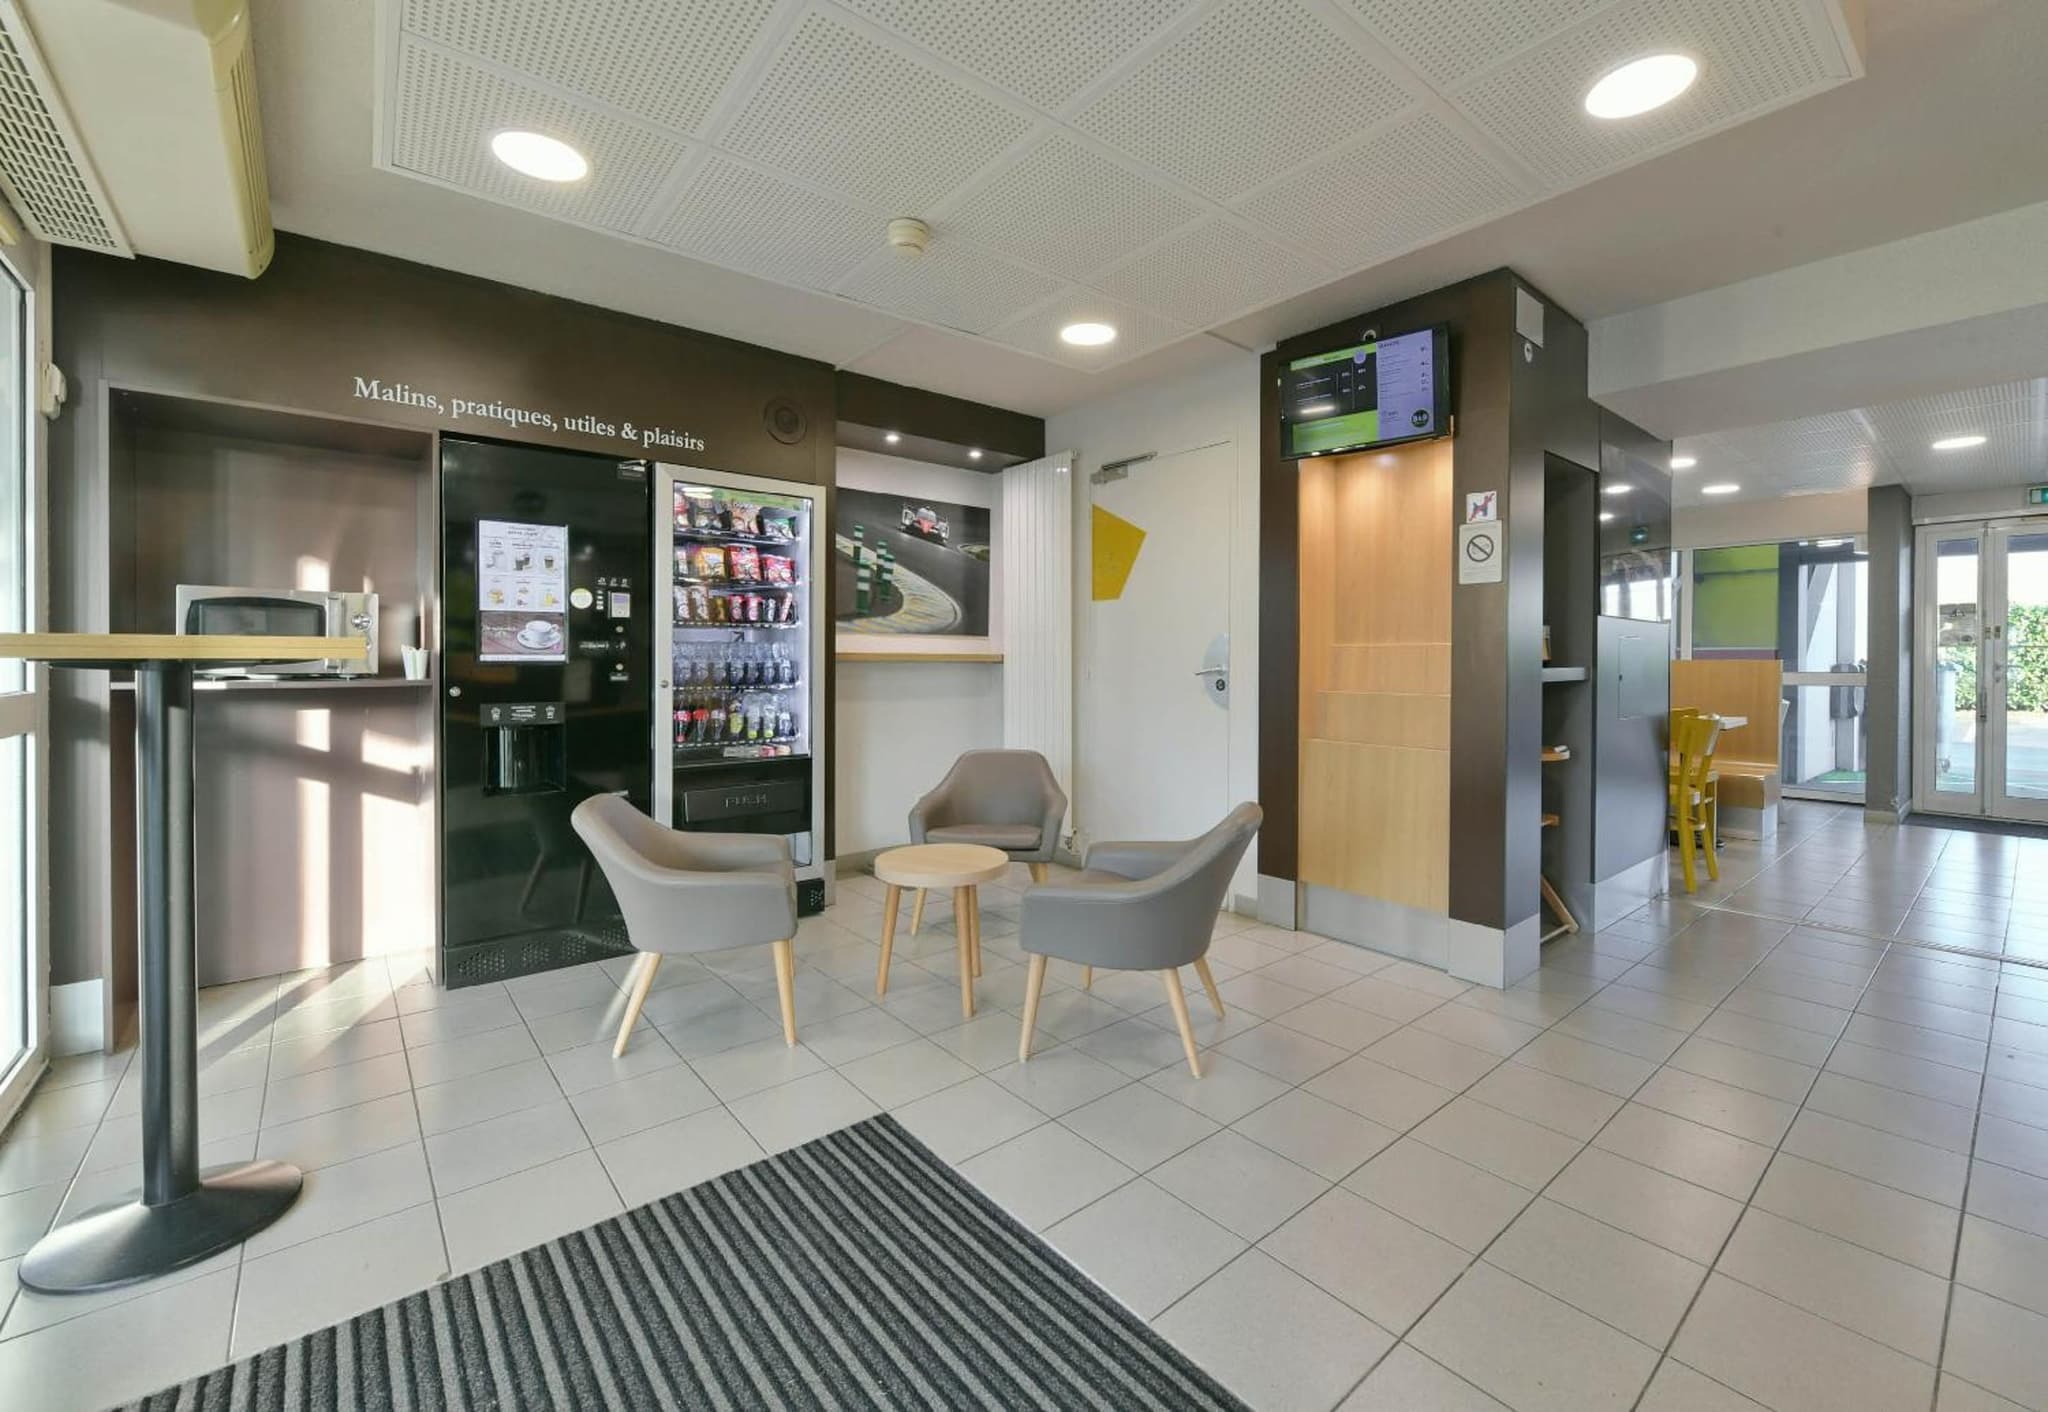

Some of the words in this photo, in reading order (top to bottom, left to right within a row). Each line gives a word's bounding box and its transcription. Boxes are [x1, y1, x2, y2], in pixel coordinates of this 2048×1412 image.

[353, 376, 444, 415] Malins,
[451, 398, 558, 432] pratiques,
[564, 415, 616, 437] utiles
[621, 422, 638, 440] &
[642, 427, 705, 451] plaisirs
